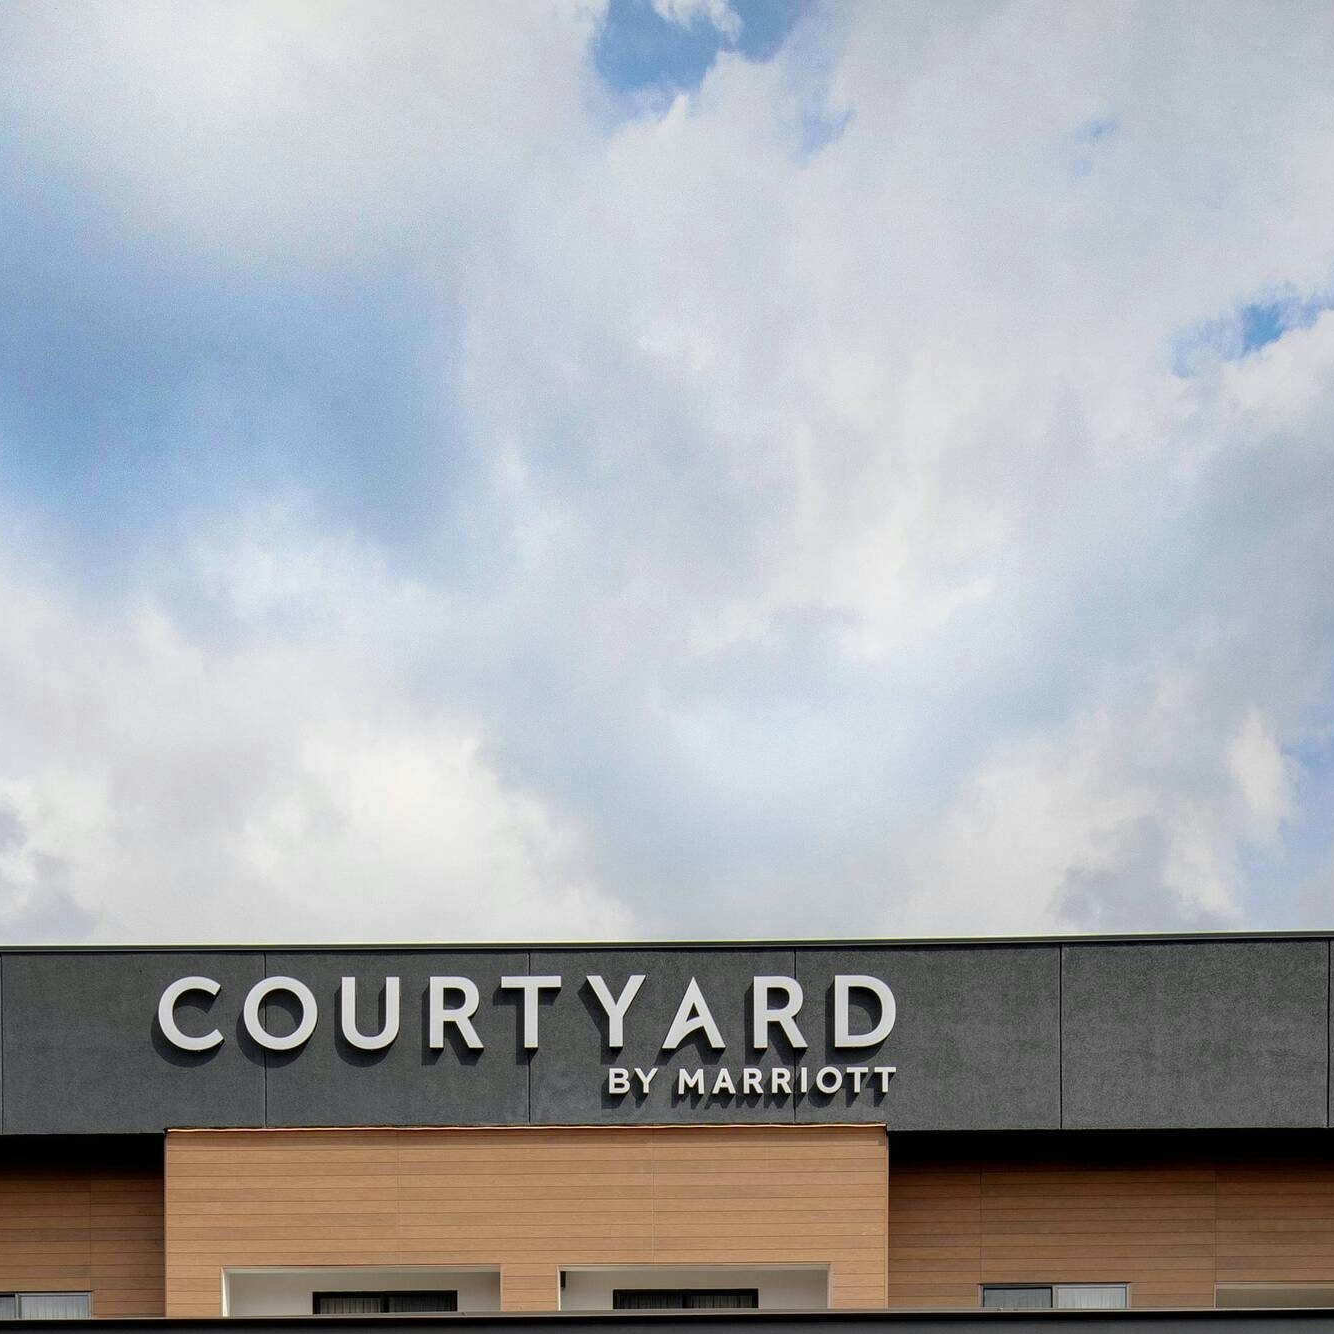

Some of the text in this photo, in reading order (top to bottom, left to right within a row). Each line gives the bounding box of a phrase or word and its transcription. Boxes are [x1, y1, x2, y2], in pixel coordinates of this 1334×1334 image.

[157, 974, 897, 1051] COURTYARD
[608, 1066, 897, 1095] BY MARRIOTT
